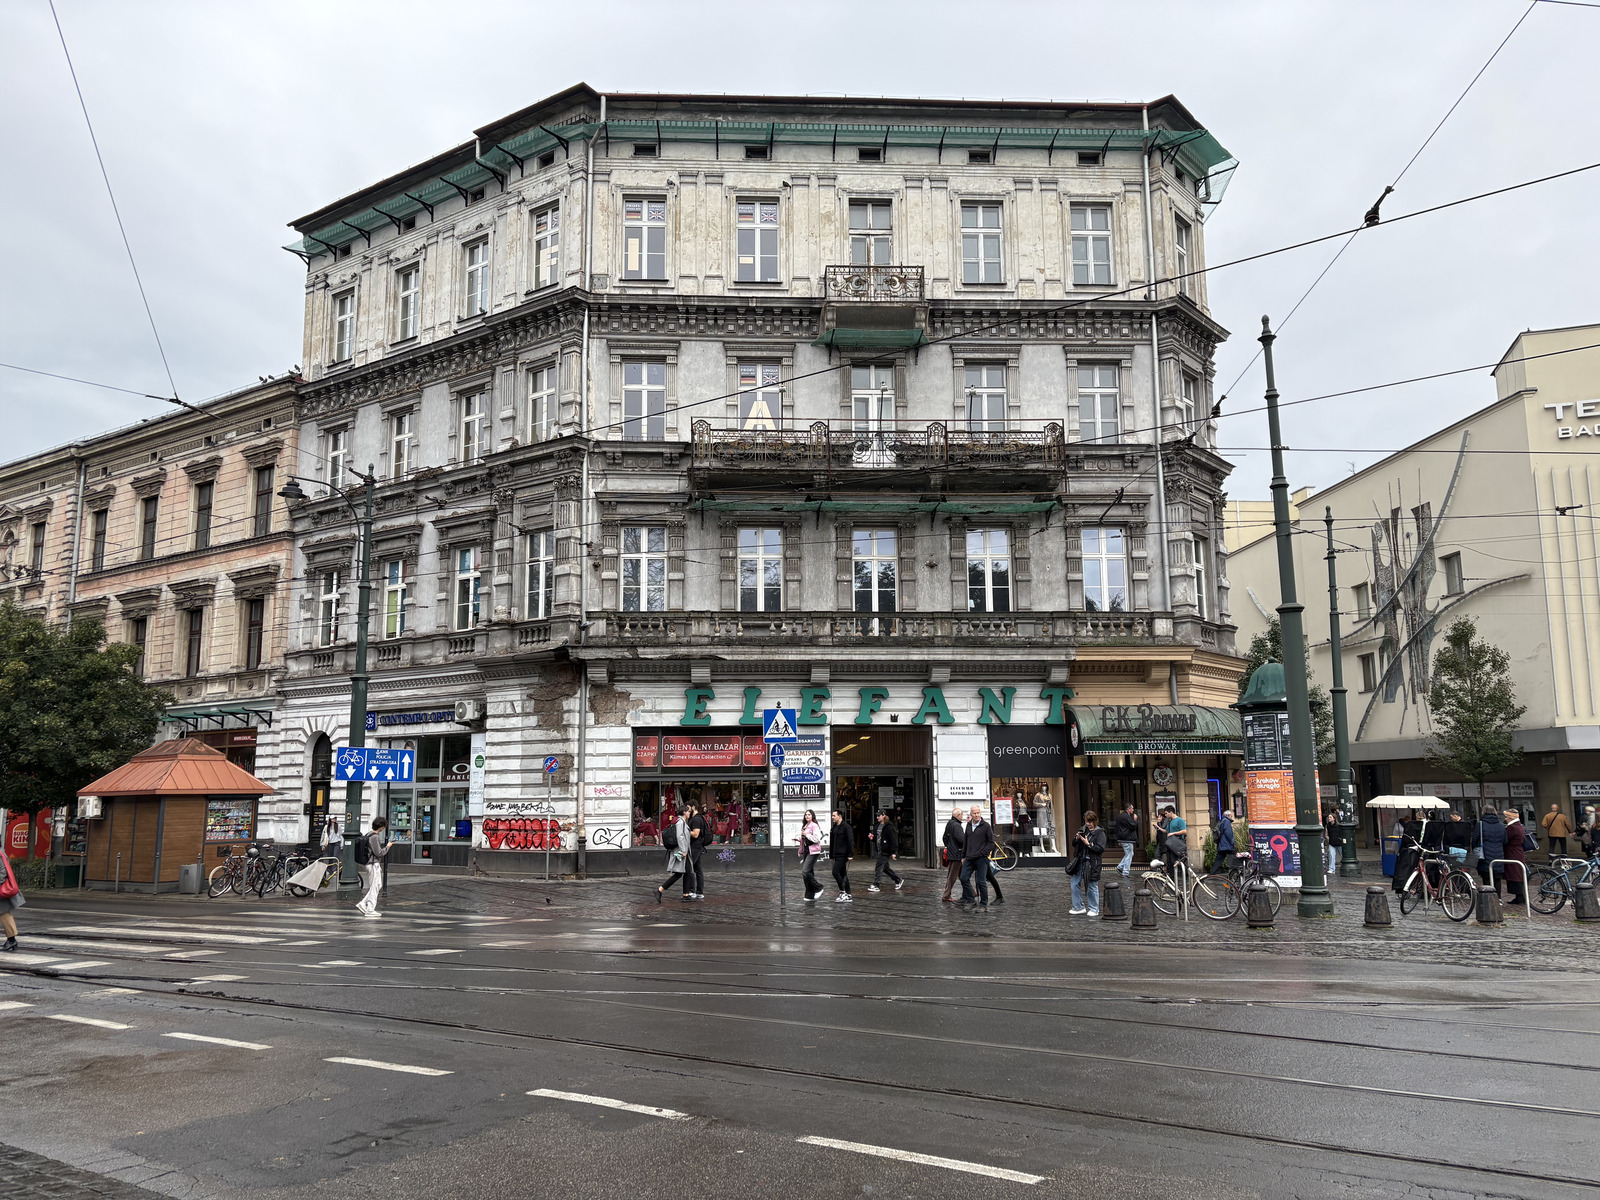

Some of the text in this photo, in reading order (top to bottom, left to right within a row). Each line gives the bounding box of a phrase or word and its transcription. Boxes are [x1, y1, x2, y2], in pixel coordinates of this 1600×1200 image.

[680, 687, 1074, 726] ELEFANT
[430, 711, 455, 722] OPTY
[993, 744, 1060, 758] greenpoint
[782, 767, 821, 777] BIELIZNA
[784, 785, 820, 795] NEW GIRL
